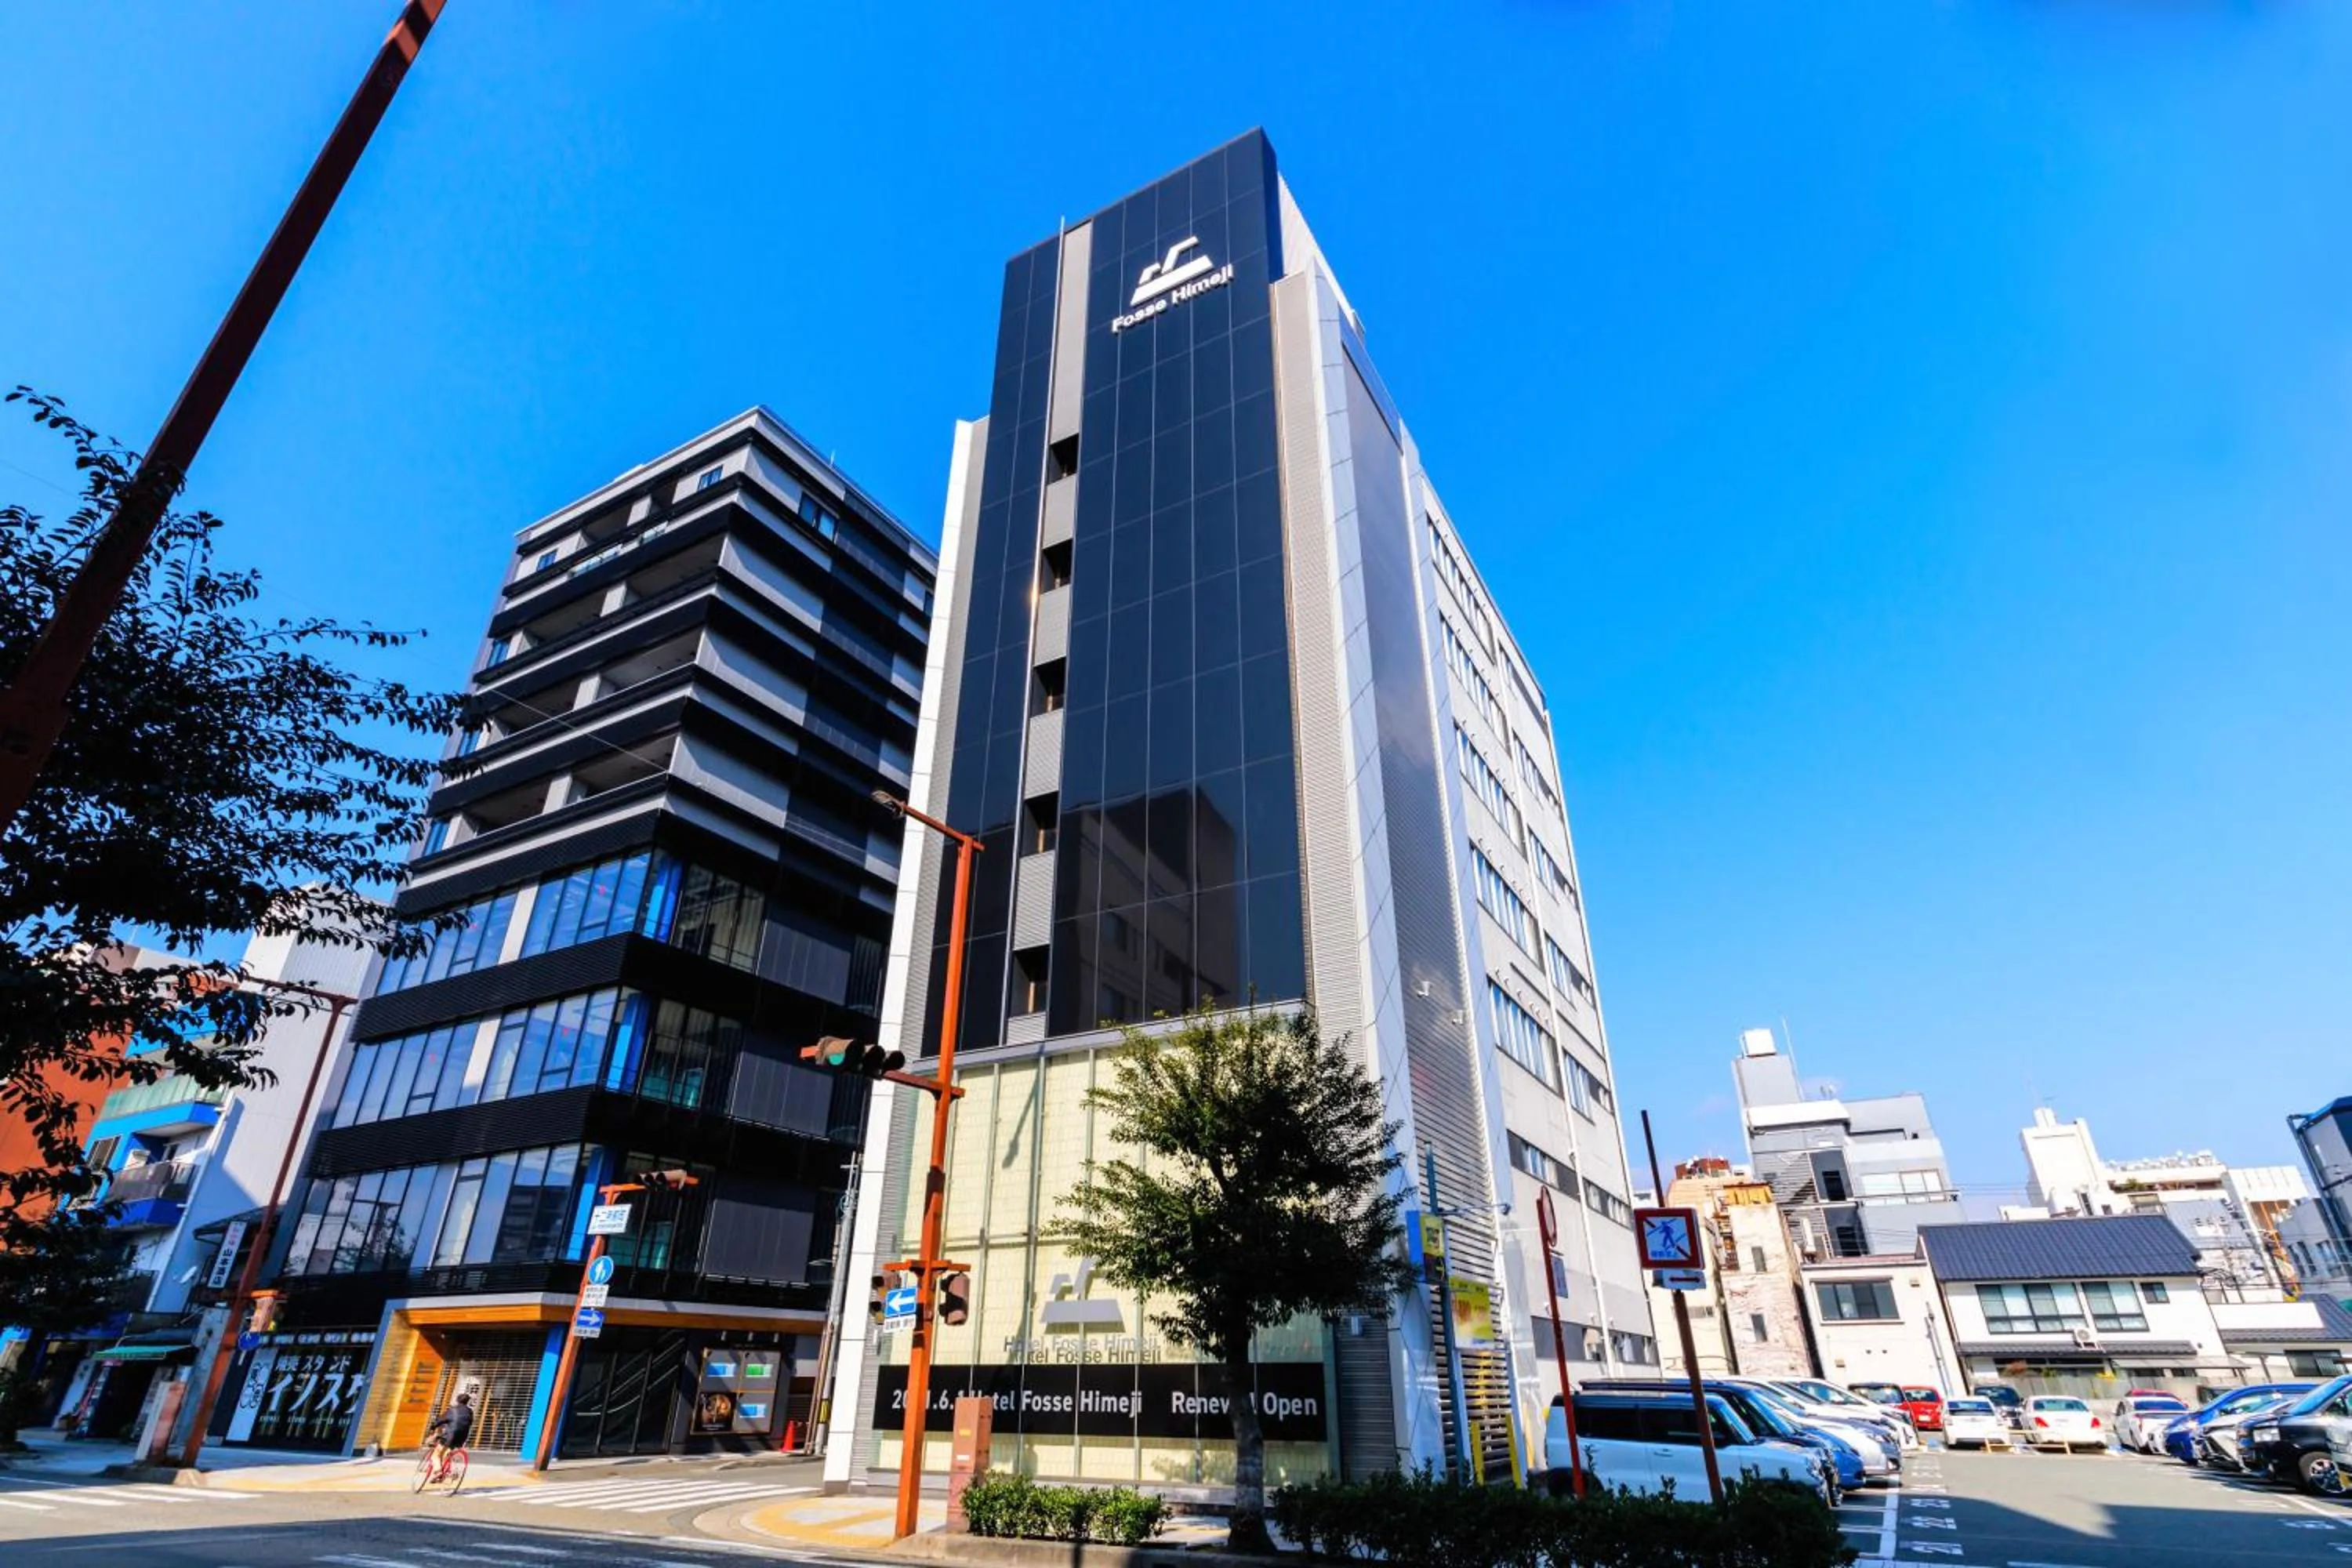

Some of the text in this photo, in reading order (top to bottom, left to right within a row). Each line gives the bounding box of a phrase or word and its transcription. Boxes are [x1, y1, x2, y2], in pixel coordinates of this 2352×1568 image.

[1112, 263, 1234, 333] Fosse Himeji
[1052, 1334, 1098, 1352] Fosse
[1022, 1390, 1073, 1412] Fosse
[1080, 1390, 1142, 1419] Himeji
[1263, 1392, 1318, 1421] Open
